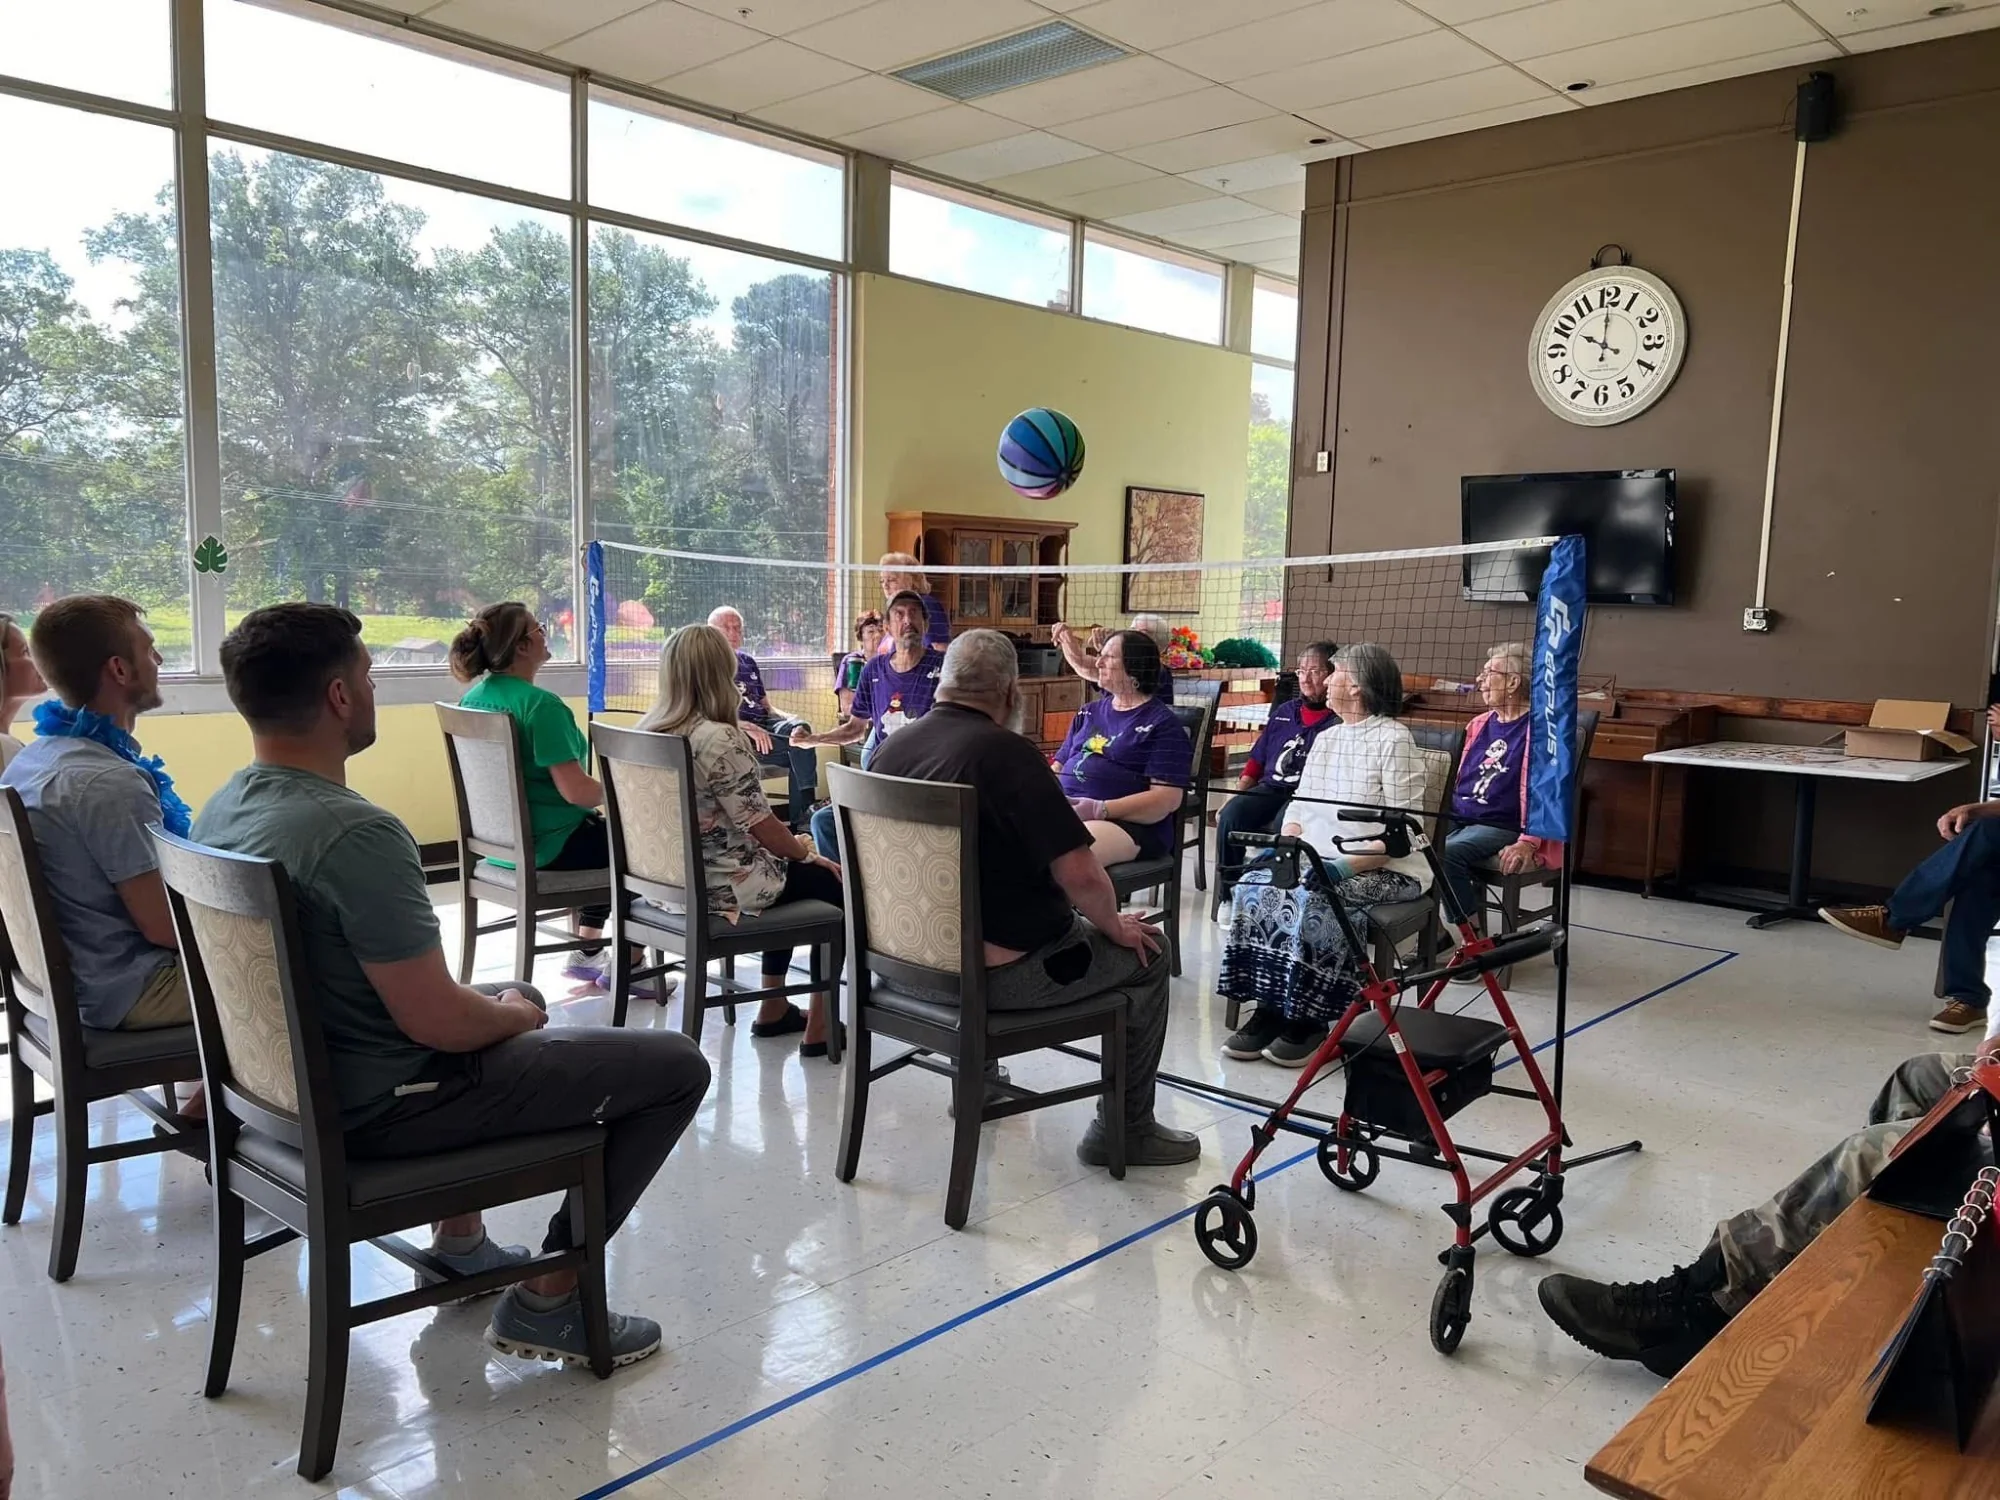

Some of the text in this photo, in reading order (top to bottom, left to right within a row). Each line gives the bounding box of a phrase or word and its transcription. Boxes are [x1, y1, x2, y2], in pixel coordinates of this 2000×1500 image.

[1573, 294, 1594, 319] 11
[1599, 286, 1621, 308] 12
[1623, 292, 1640, 313] 1
[1553, 314, 1577, 339] 10
[1636, 307, 1659, 328] 2
[1547, 343, 1567, 358] 9
[1643, 334, 1665, 351] 3
[1552, 364, 1572, 384] 8
[1636, 358, 1657, 377] 4
[1571, 379, 1589, 400] 7
[1594, 384, 1609, 406] 6
[1616, 376, 1635, 398] 5
